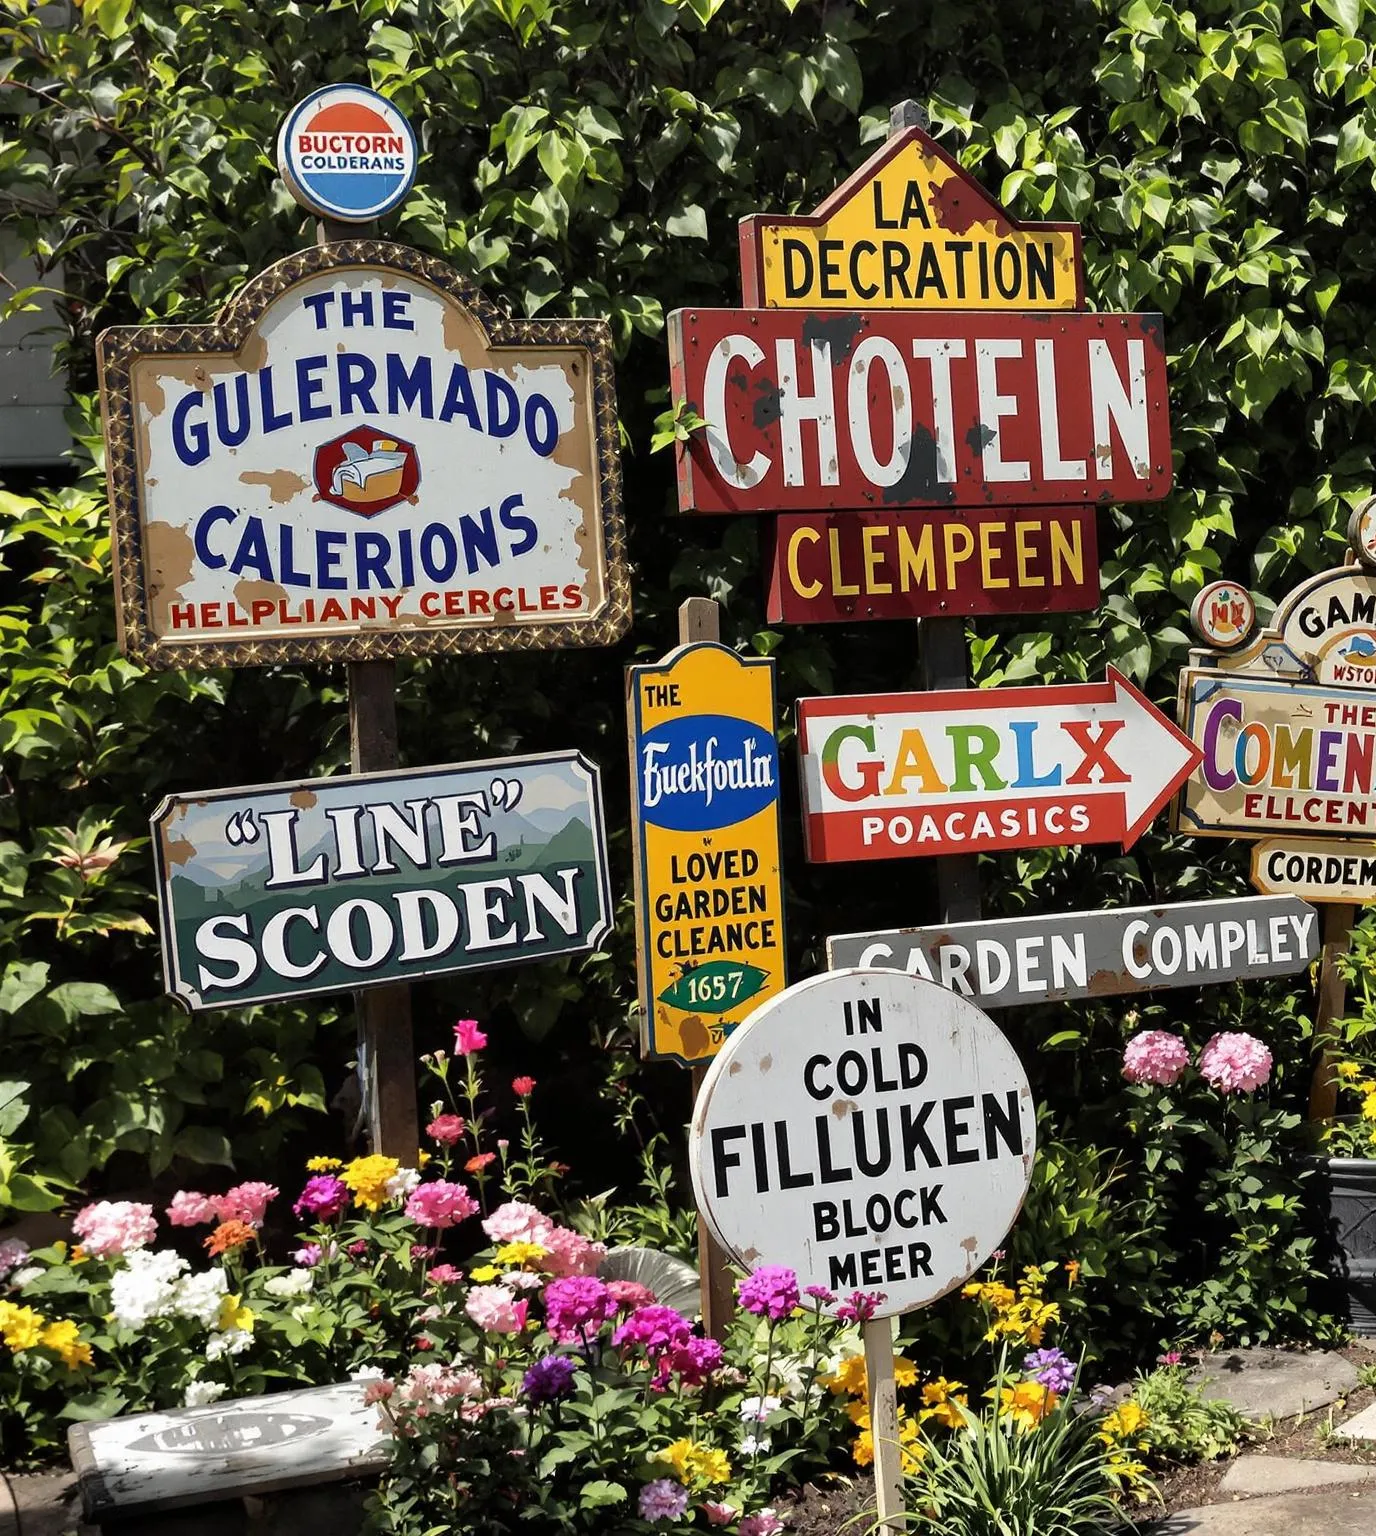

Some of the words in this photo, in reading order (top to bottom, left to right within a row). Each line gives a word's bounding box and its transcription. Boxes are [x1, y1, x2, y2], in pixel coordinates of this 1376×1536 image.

[298, 134, 404, 155] BUCTORN
[300, 154, 406, 172] COLDERANS
[872, 180, 932, 231] LA
[782, 240, 1056, 301] DECRATION
[303, 291, 416, 332] THE
[170, 352, 560, 468] GULERMADO
[703, 334, 1151, 491] CHOTELN
[193, 493, 540, 592] CALERIONS
[787, 519, 1085, 600] CLEMPEEN
[170, 594, 404, 630] HELPLIANY
[418, 585, 584, 617] CERCLES
[644, 684, 682, 708] THE
[1324, 703, 1376, 728] THE
[820, 718, 1134, 803] GARLX
[861, 804, 1092, 846] POACASICS
[670, 848, 760, 884] LOVED
[655, 884, 768, 923] GARDEN
[192, 866, 583, 992] SCODEN
[657, 919, 777, 959] CLEANCE
[1121, 912, 1316, 981] COMPLEY
[688, 971, 744, 1004] 1657
[844, 998, 884, 1036] IN
[802, 1043, 930, 1101] COLD
[709, 1091, 1024, 1199] FILLUKEN
[812, 1184, 949, 1243] BLOCK
[829, 1243, 934, 1292] MEER
